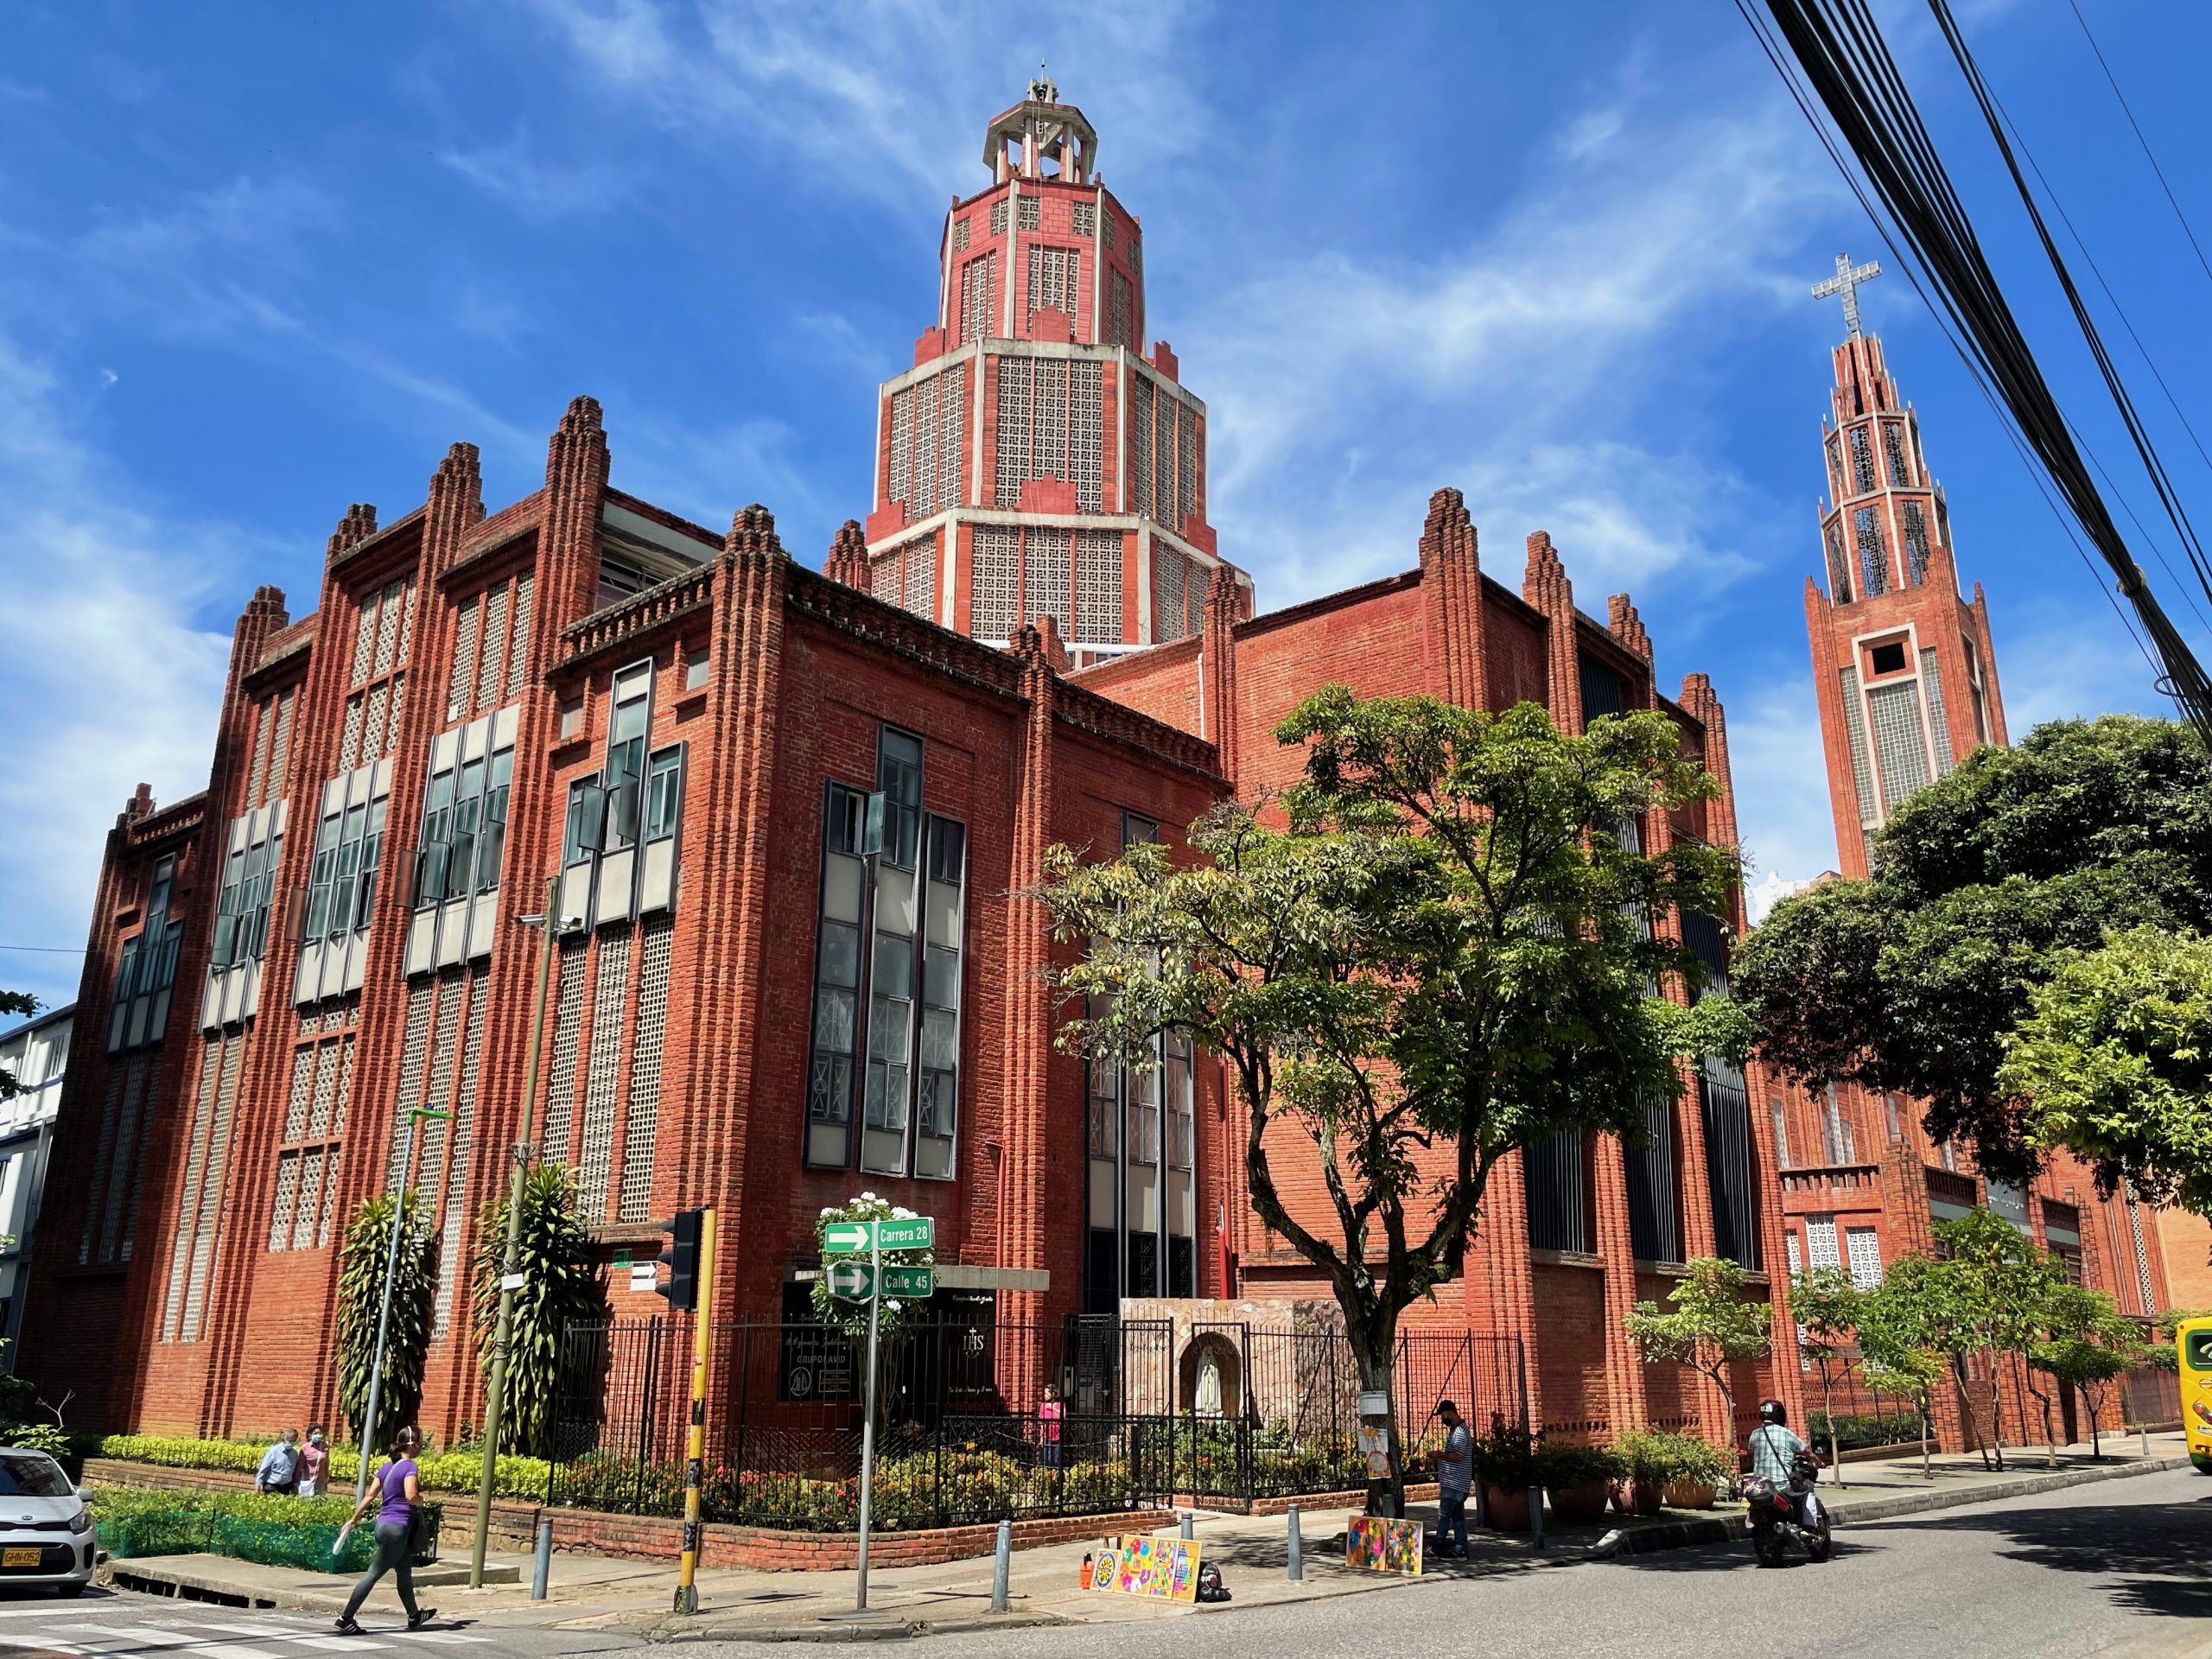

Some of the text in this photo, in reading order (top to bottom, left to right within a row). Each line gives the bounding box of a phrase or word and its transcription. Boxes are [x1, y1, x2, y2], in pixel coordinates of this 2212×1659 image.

[880, 1226, 928, 1243] Carrera 28
[885, 1274, 928, 1289] Calle 45
[963, 1335, 984, 1351] IHS
[797, 1355, 823, 1363] GRUPO
